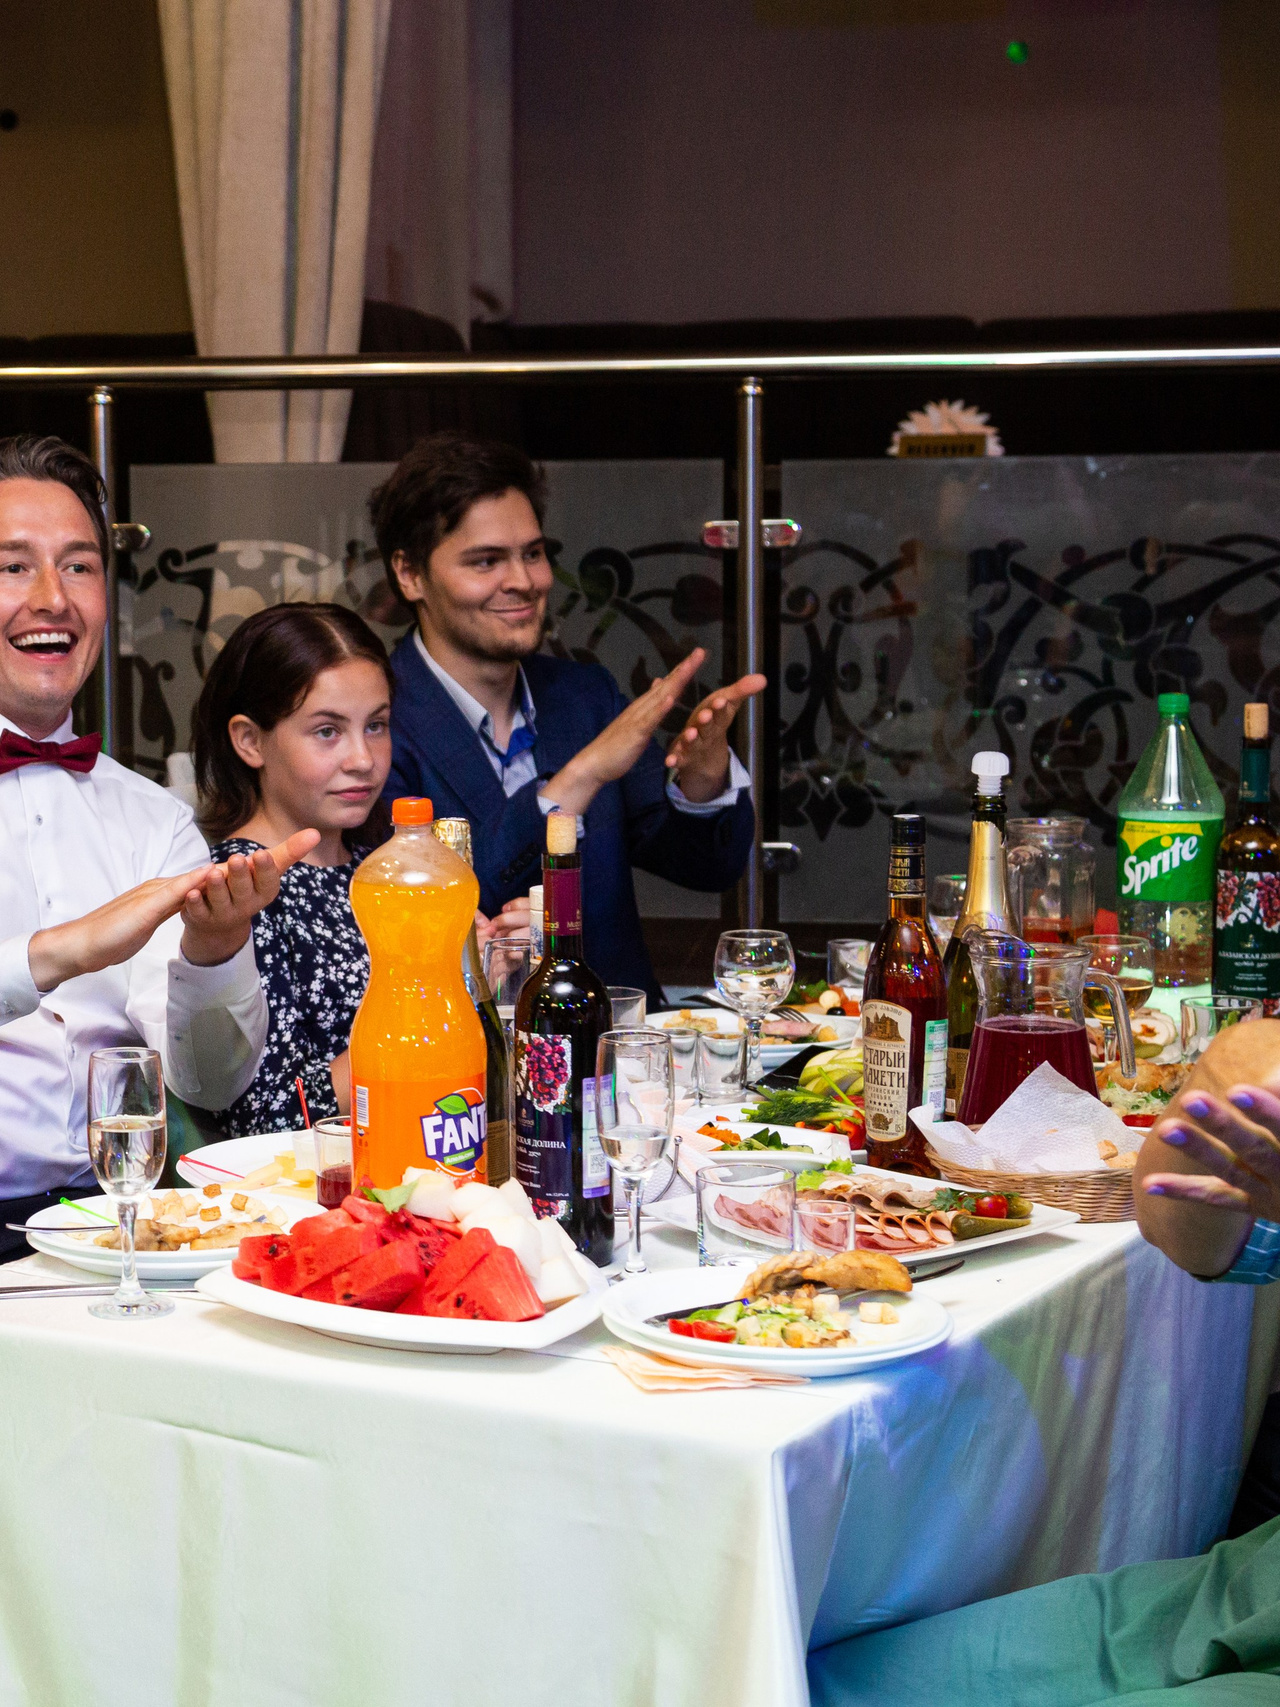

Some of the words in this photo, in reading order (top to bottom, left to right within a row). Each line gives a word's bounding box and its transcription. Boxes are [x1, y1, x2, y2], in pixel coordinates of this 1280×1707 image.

[1121, 834, 1199, 896] Sprite
[864, 1044, 906, 1069] СТАРЫЙ
[864, 1067, 906, 1089] КАХЕТИ
[866, 1084, 900, 1096] РУЗИНСКИЙ
[422, 1102, 487, 1156] FANT
[516, 1134, 532, 1146] СКАЯ
[531, 1138, 567, 1149] ДОЛИНА
